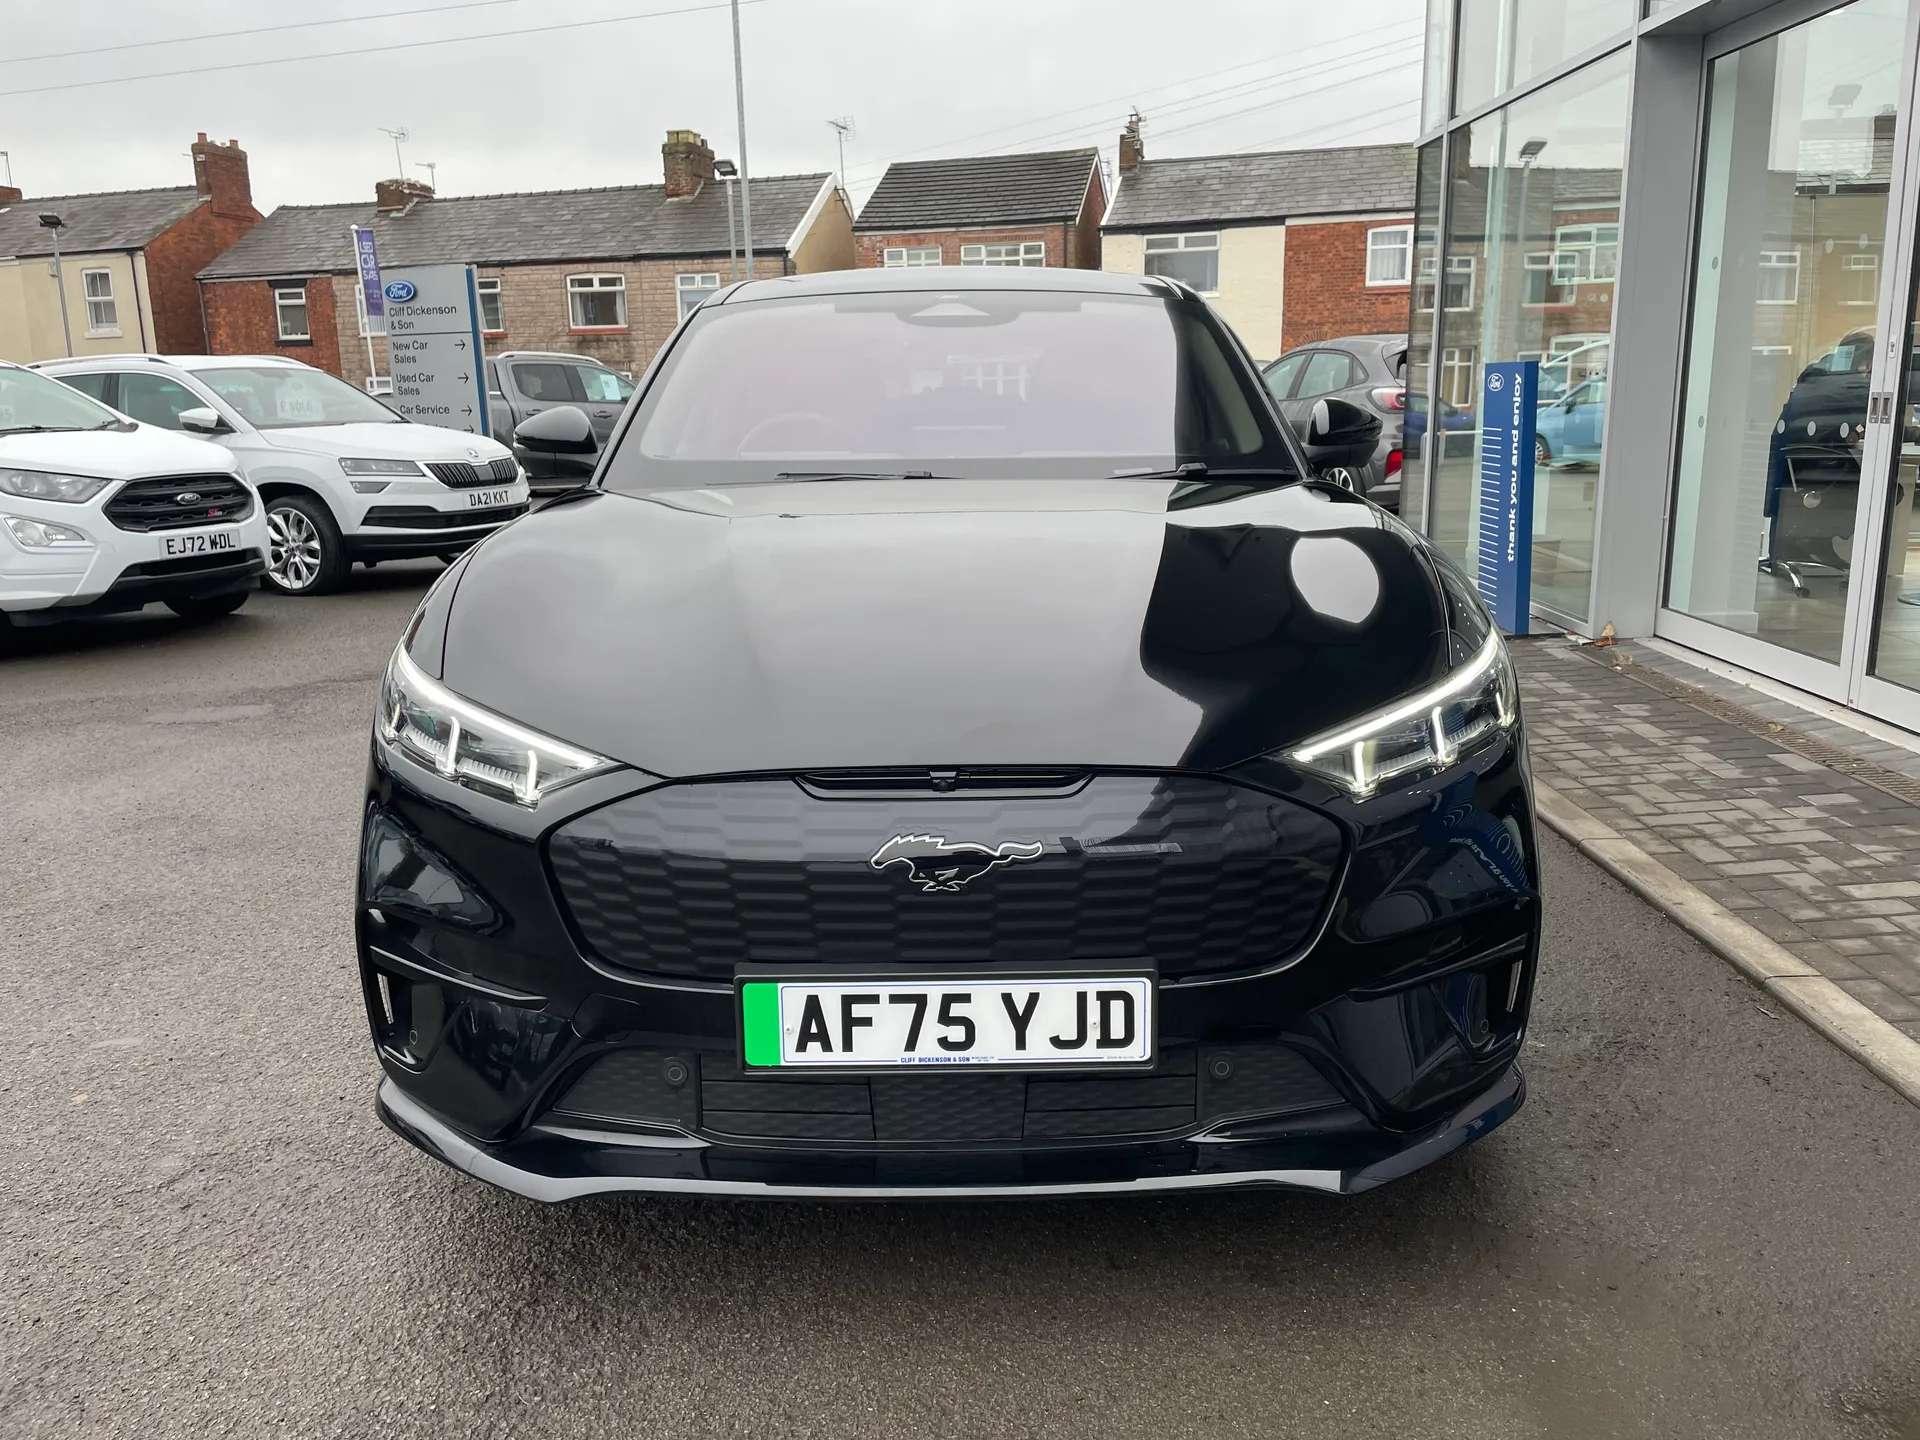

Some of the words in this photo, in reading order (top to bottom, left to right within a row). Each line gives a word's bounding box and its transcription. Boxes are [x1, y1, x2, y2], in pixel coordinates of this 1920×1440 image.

[389, 284, 408, 298] Ford
[389, 306, 405, 318] Cliff
[406, 305, 457, 317] Dickenson
[391, 322, 397, 331] &
[397, 321, 414, 331] Son
[392, 341, 410, 351] New
[412, 340, 428, 351] Car
[394, 354, 417, 364] Sales
[396, 373, 417, 383] Used
[418, 372, 435, 383] Car
[1489, 374, 1503, 390] Ford
[397, 386, 420, 396] Sales
[1512, 373, 1522, 426] enjoy
[400, 405, 413, 415] Car
[415, 404, 450, 415] Service
[1511, 429, 1519, 467] and
[1510, 470, 1518, 504] you
[469, 492, 492, 507] DA21
[493, 490, 509, 504] KKT
[1507, 508, 1516, 562] thank
[166, 536, 206, 555] EJ72
[208, 533, 236, 550] WDL
[795, 992, 976, 1053] AF75
